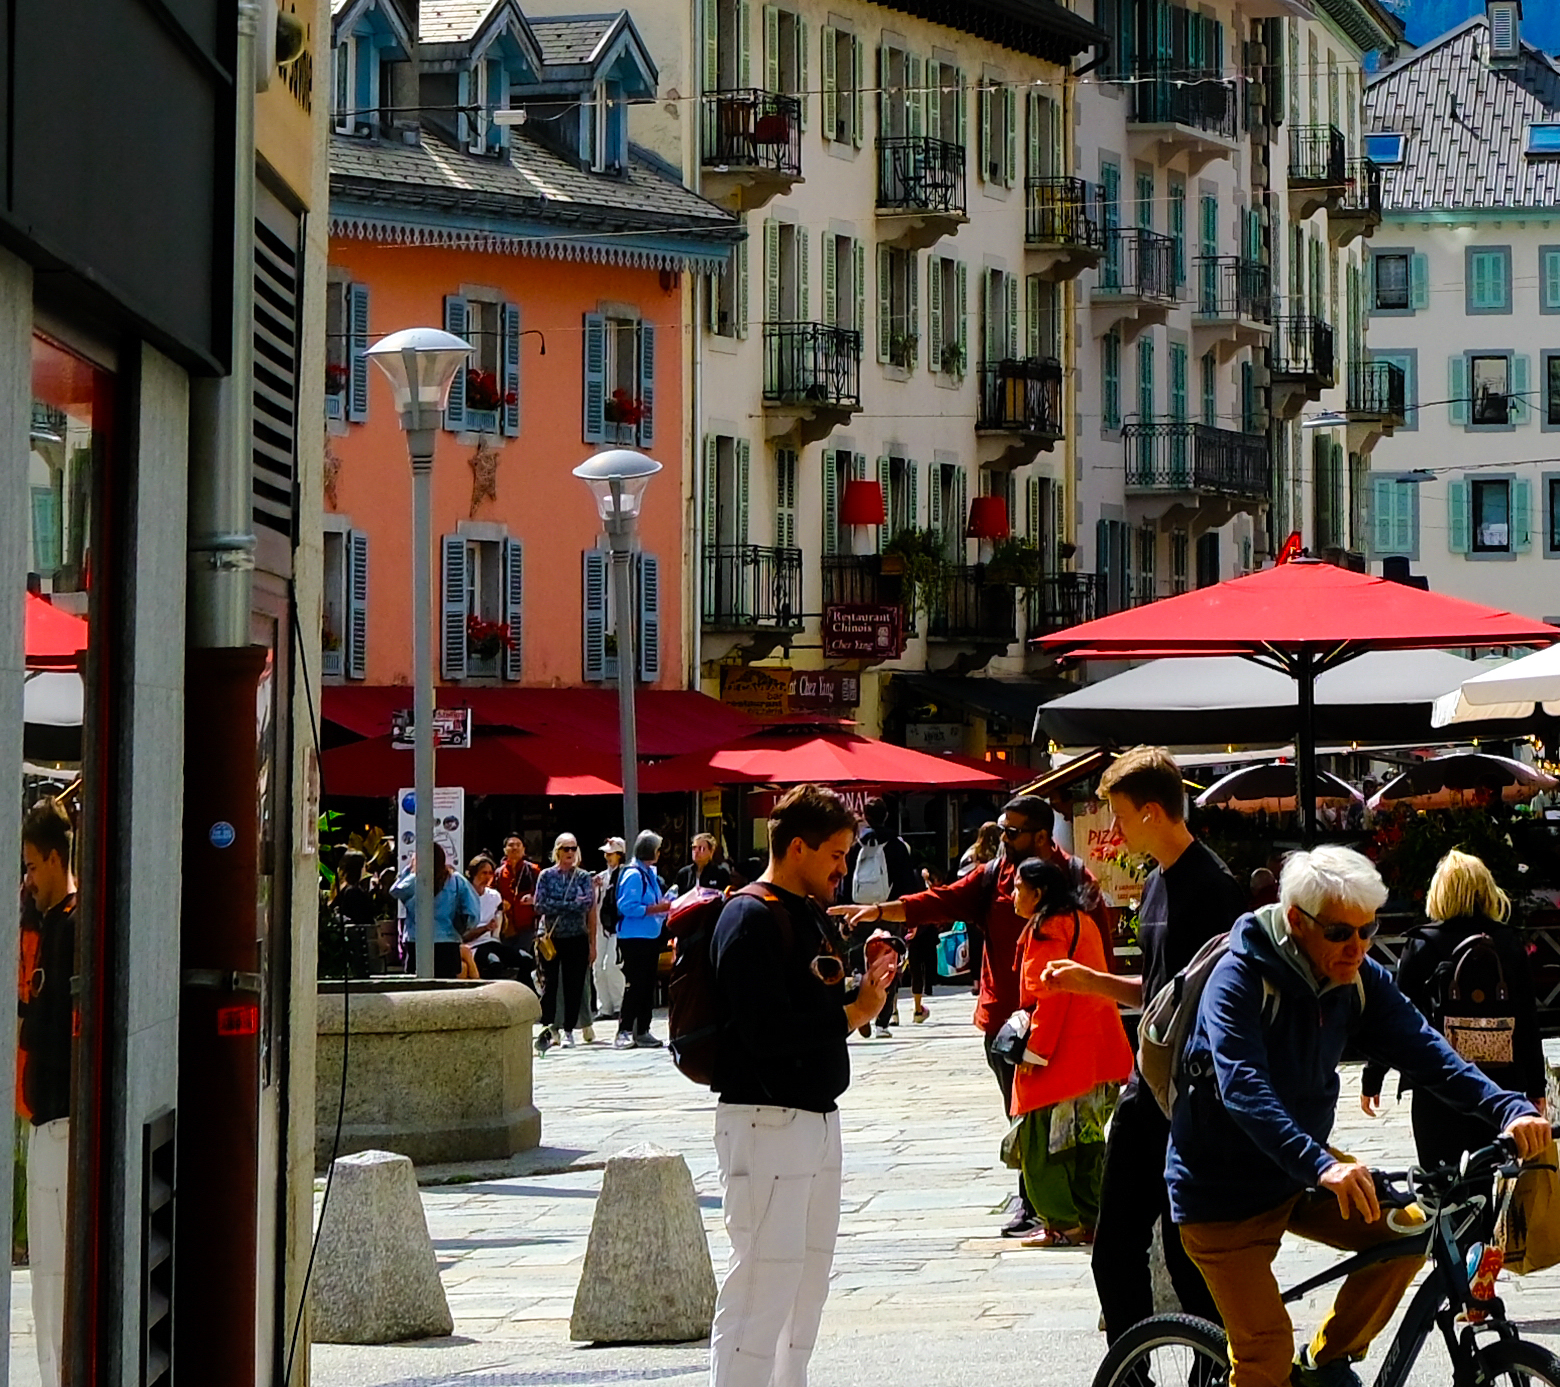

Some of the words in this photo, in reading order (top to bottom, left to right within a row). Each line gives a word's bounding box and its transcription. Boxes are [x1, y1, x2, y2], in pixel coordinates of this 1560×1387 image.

[832, 611, 891, 623] Restaurant
[832, 622, 873, 633] Chinois
[832, 639, 852, 649] Chez
[799, 675, 817, 696] Chez
